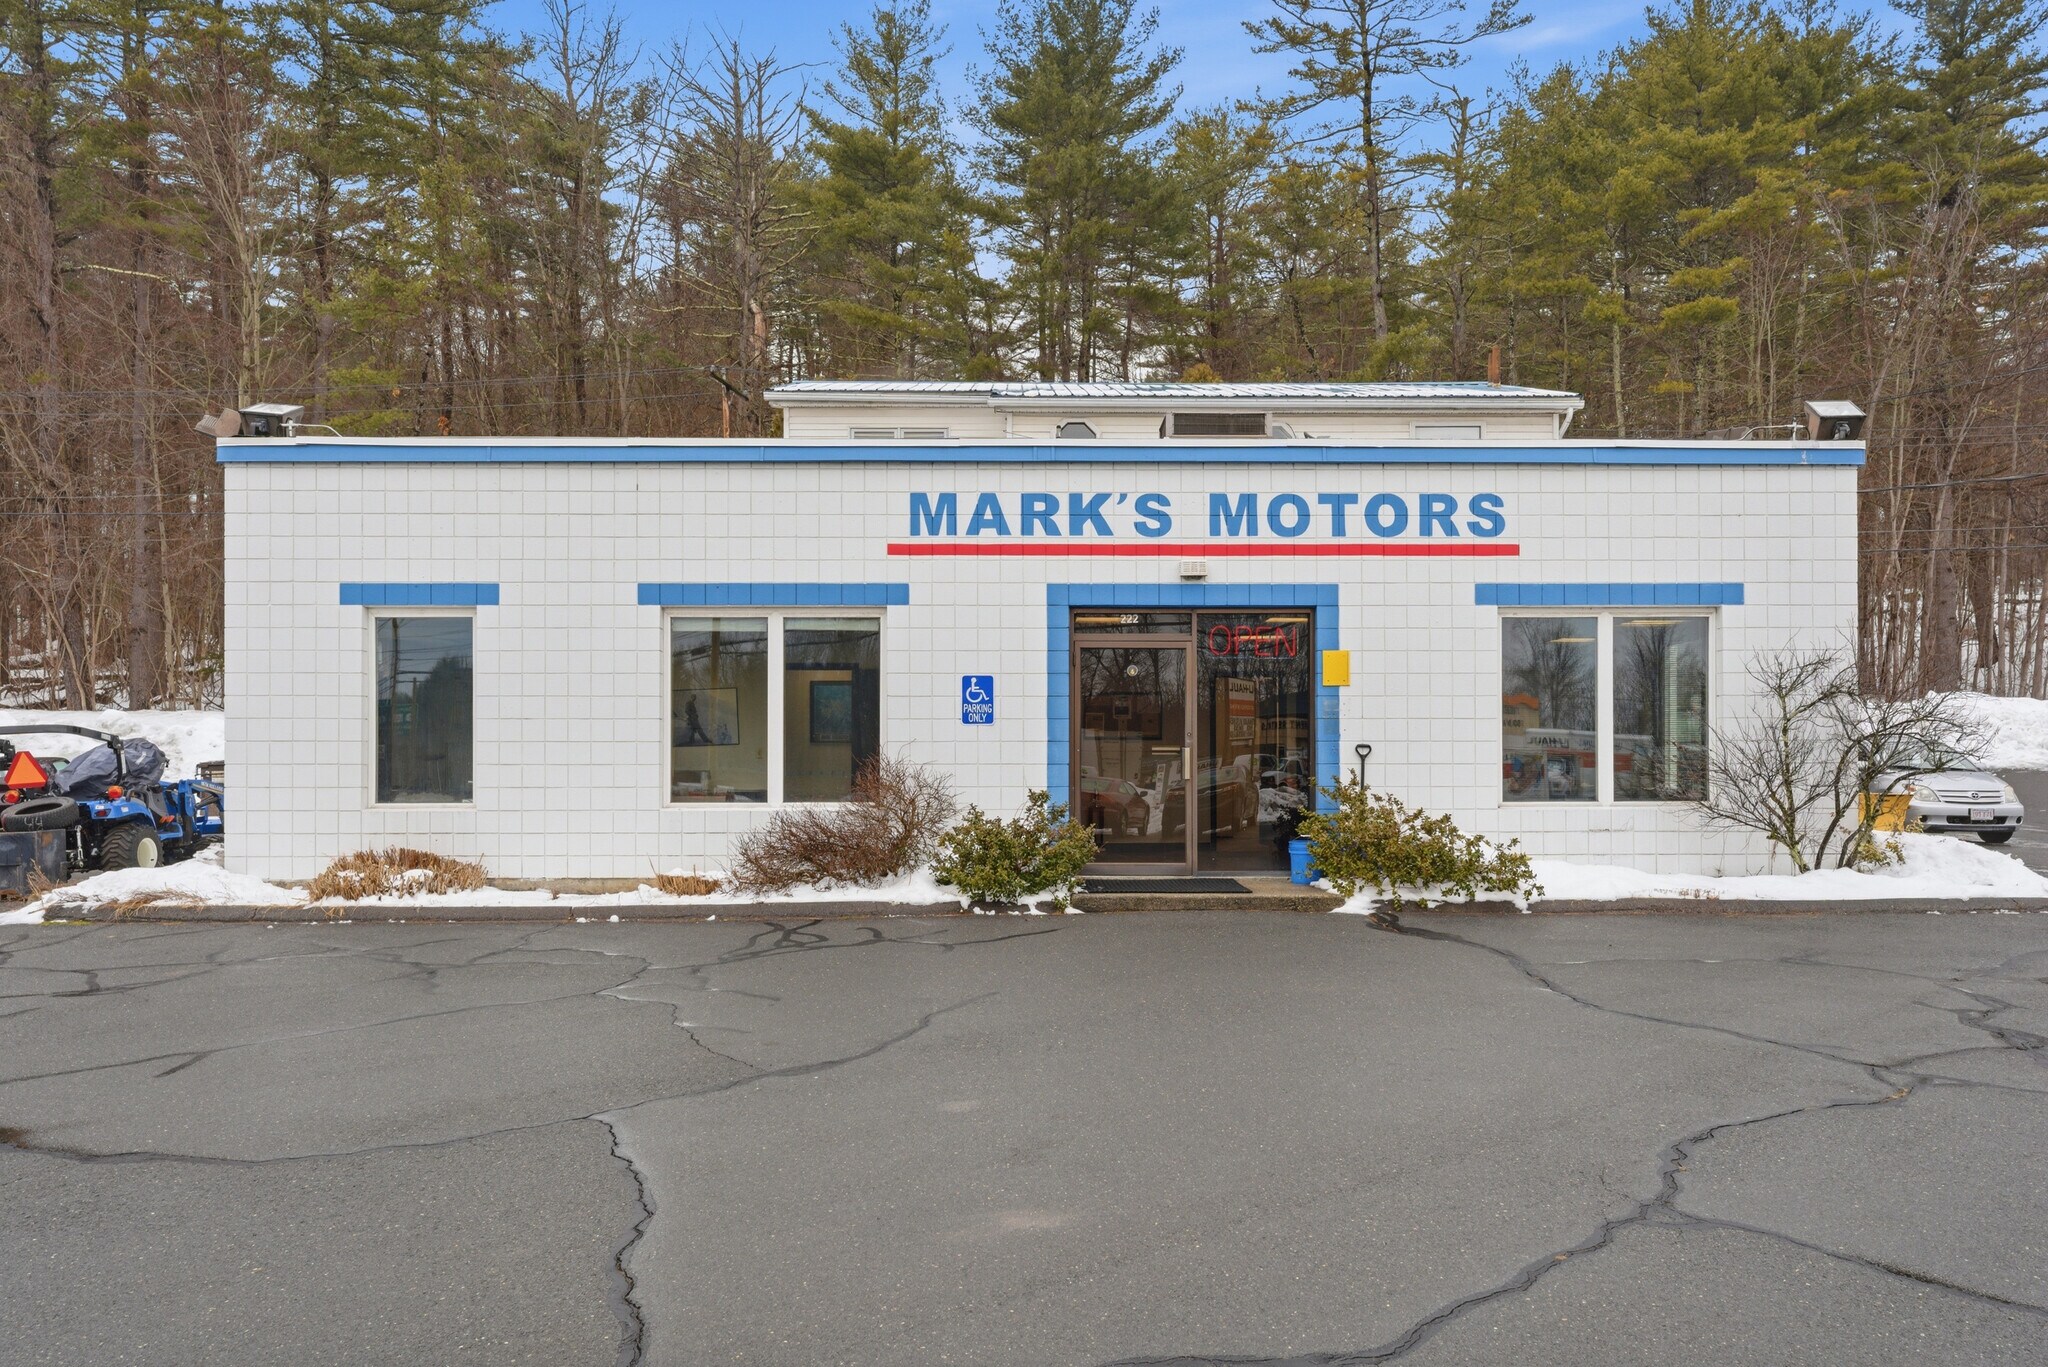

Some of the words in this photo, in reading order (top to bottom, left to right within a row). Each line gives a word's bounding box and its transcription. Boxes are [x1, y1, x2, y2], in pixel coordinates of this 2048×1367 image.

[909, 492, 1173, 538] MARK'S
[1208, 492, 1507, 539] MOTORS
[1120, 614, 1140, 625] 222
[1209, 625, 1297, 658] OPEN
[963, 703, 993, 714] PARKING
[968, 713, 987, 723] ONLY
